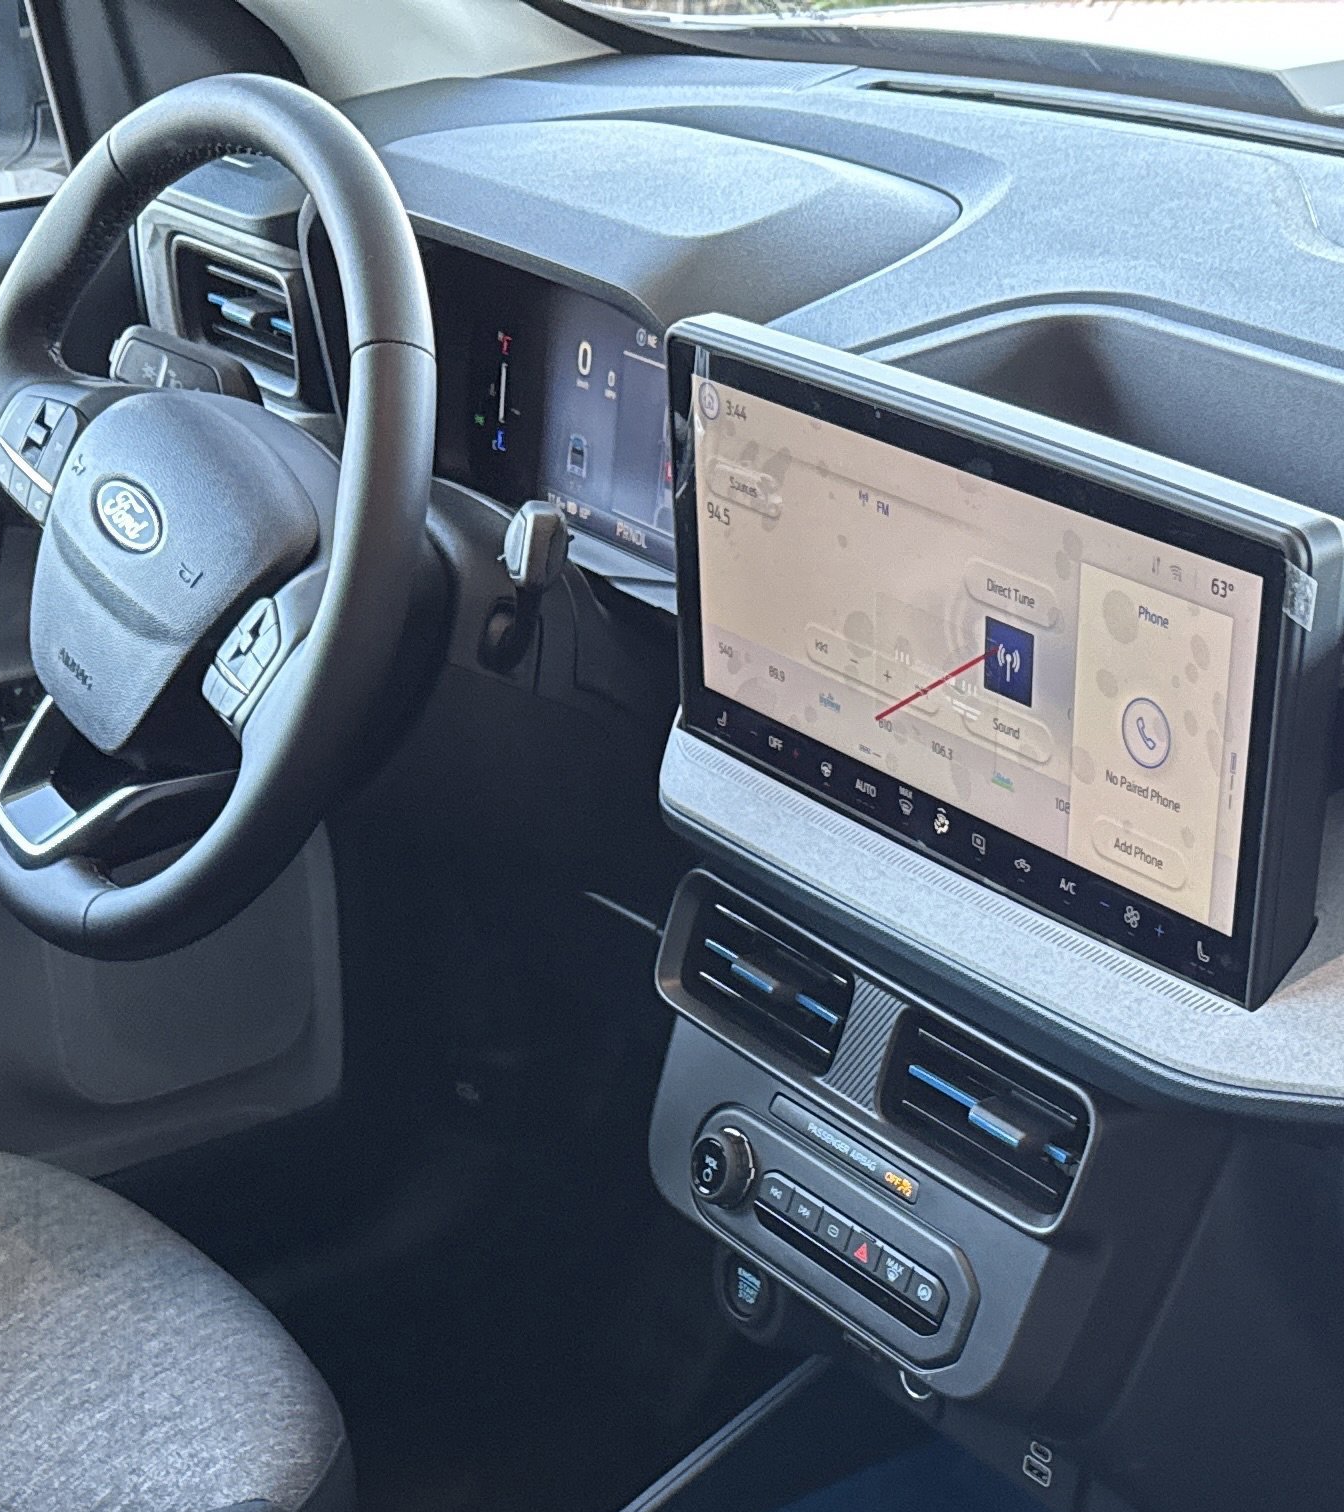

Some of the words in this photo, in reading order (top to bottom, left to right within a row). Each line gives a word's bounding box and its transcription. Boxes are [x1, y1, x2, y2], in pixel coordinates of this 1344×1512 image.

[578, 340, 592, 376] 0
[726, 401, 747, 421] 3:44
[103, 491, 149, 540] Ford
[707, 502, 731, 526] 94.5
[876, 501, 890, 517] FM
[986, 578, 1012, 600] Direct
[1013, 588, 1035, 609] Tune
[1211, 578, 1234, 599] 63°
[1138, 605, 1169, 630] Phone
[992, 717, 1020, 740] Sound
[768, 735, 783, 751] OFF
[856, 778, 877, 798] AUTO
[1106, 769, 1118, 785] No
[1120, 776, 1149, 799] Paired
[1150, 789, 1181, 813] Phone
[1114, 837, 1133, 856] Add
[1133, 846, 1163, 870] Phone
[1059, 878, 1077, 895] A/C
[807, 1122, 850, 1155] PASSENGER
[849, 1148, 877, 1172] AIRBAG
[886, 1257, 905, 1275] MAX
